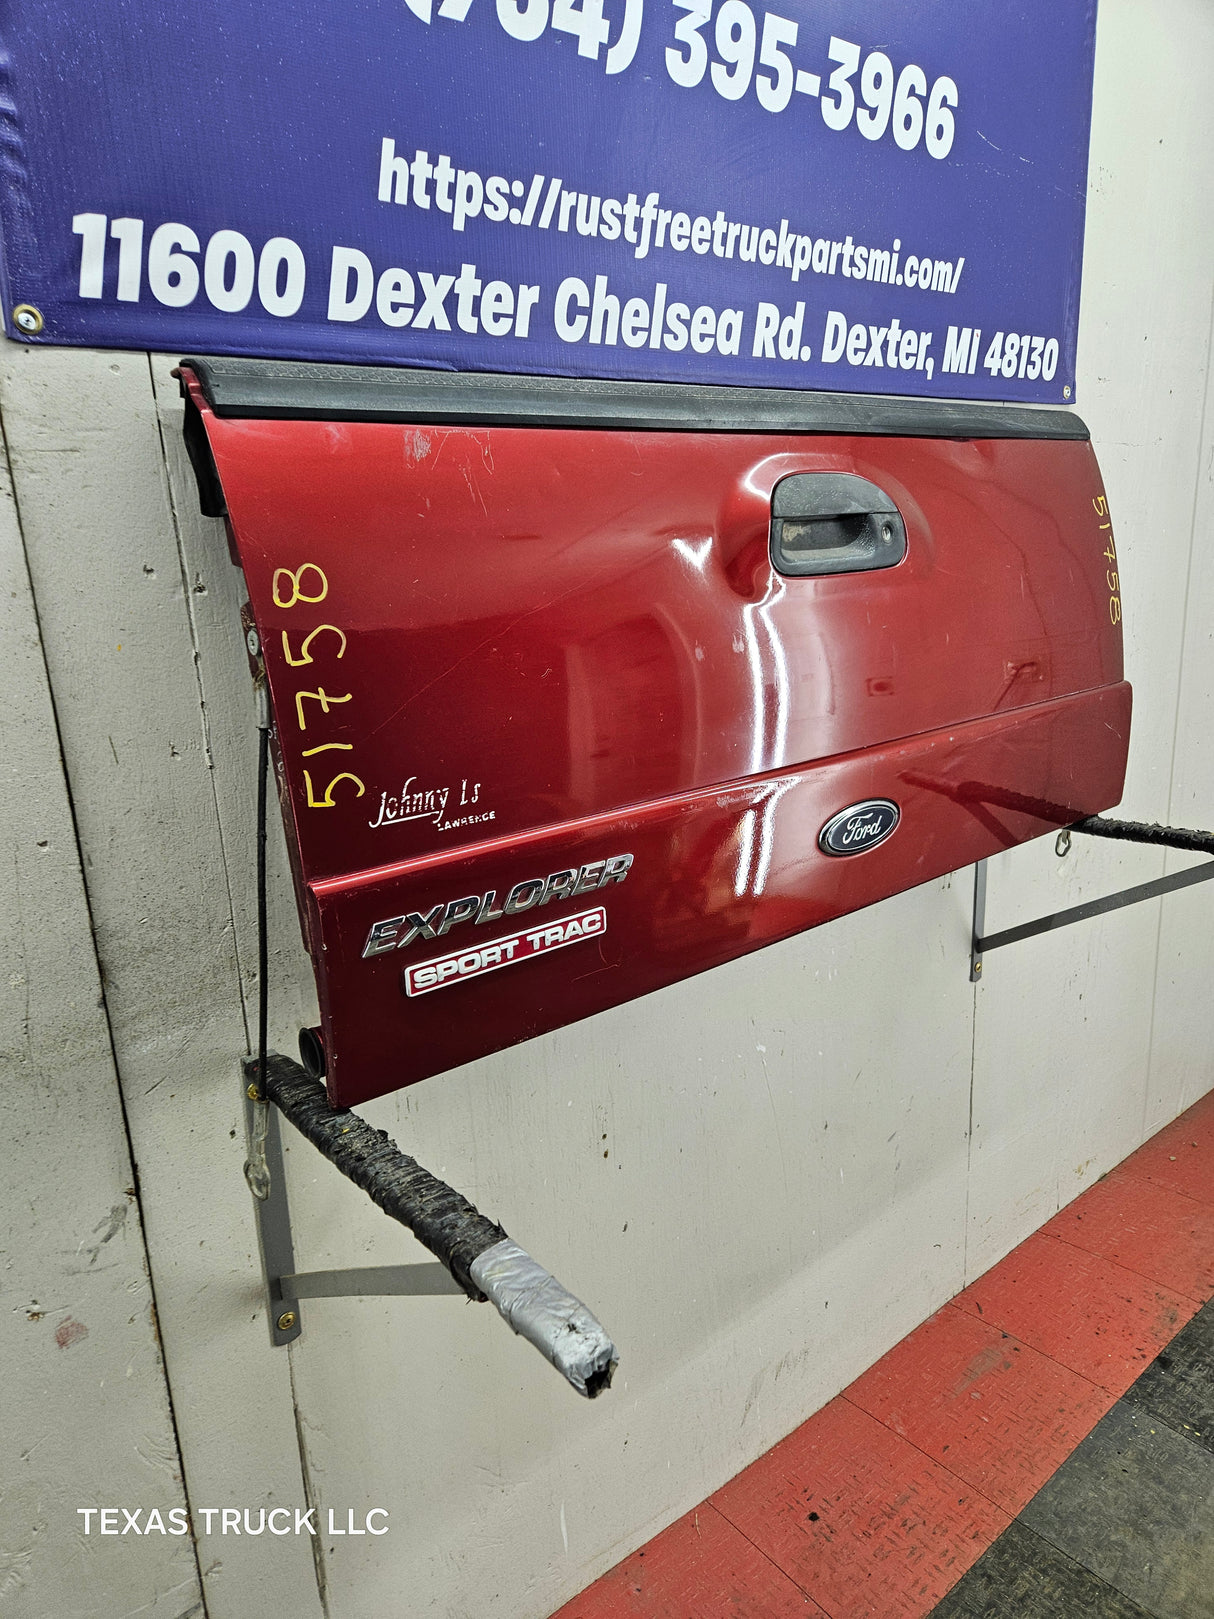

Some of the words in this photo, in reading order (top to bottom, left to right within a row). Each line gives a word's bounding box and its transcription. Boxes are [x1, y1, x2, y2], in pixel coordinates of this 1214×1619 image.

[665, 0, 959, 160] 395-3966
[377, 138, 965, 294] https://rustfreetruckpartsmi.com/
[72, 212, 306, 317] 11600
[327, 245, 540, 338] Dexter
[554, 275, 744, 356] Chelsea
[752, 302, 812, 362] Rd.
[821, 311, 935, 380] Dexter,
[942, 326, 982, 374] MI
[983, 331, 1059, 382] 48130
[1092, 495, 1121, 626] 51758
[272, 562, 366, 808] 51758
[842, 812, 883, 845] Ford
[361, 853, 635, 959] EXPLORER
[413, 940, 520, 990] SPORT
[527, 913, 602, 951] TRAC
